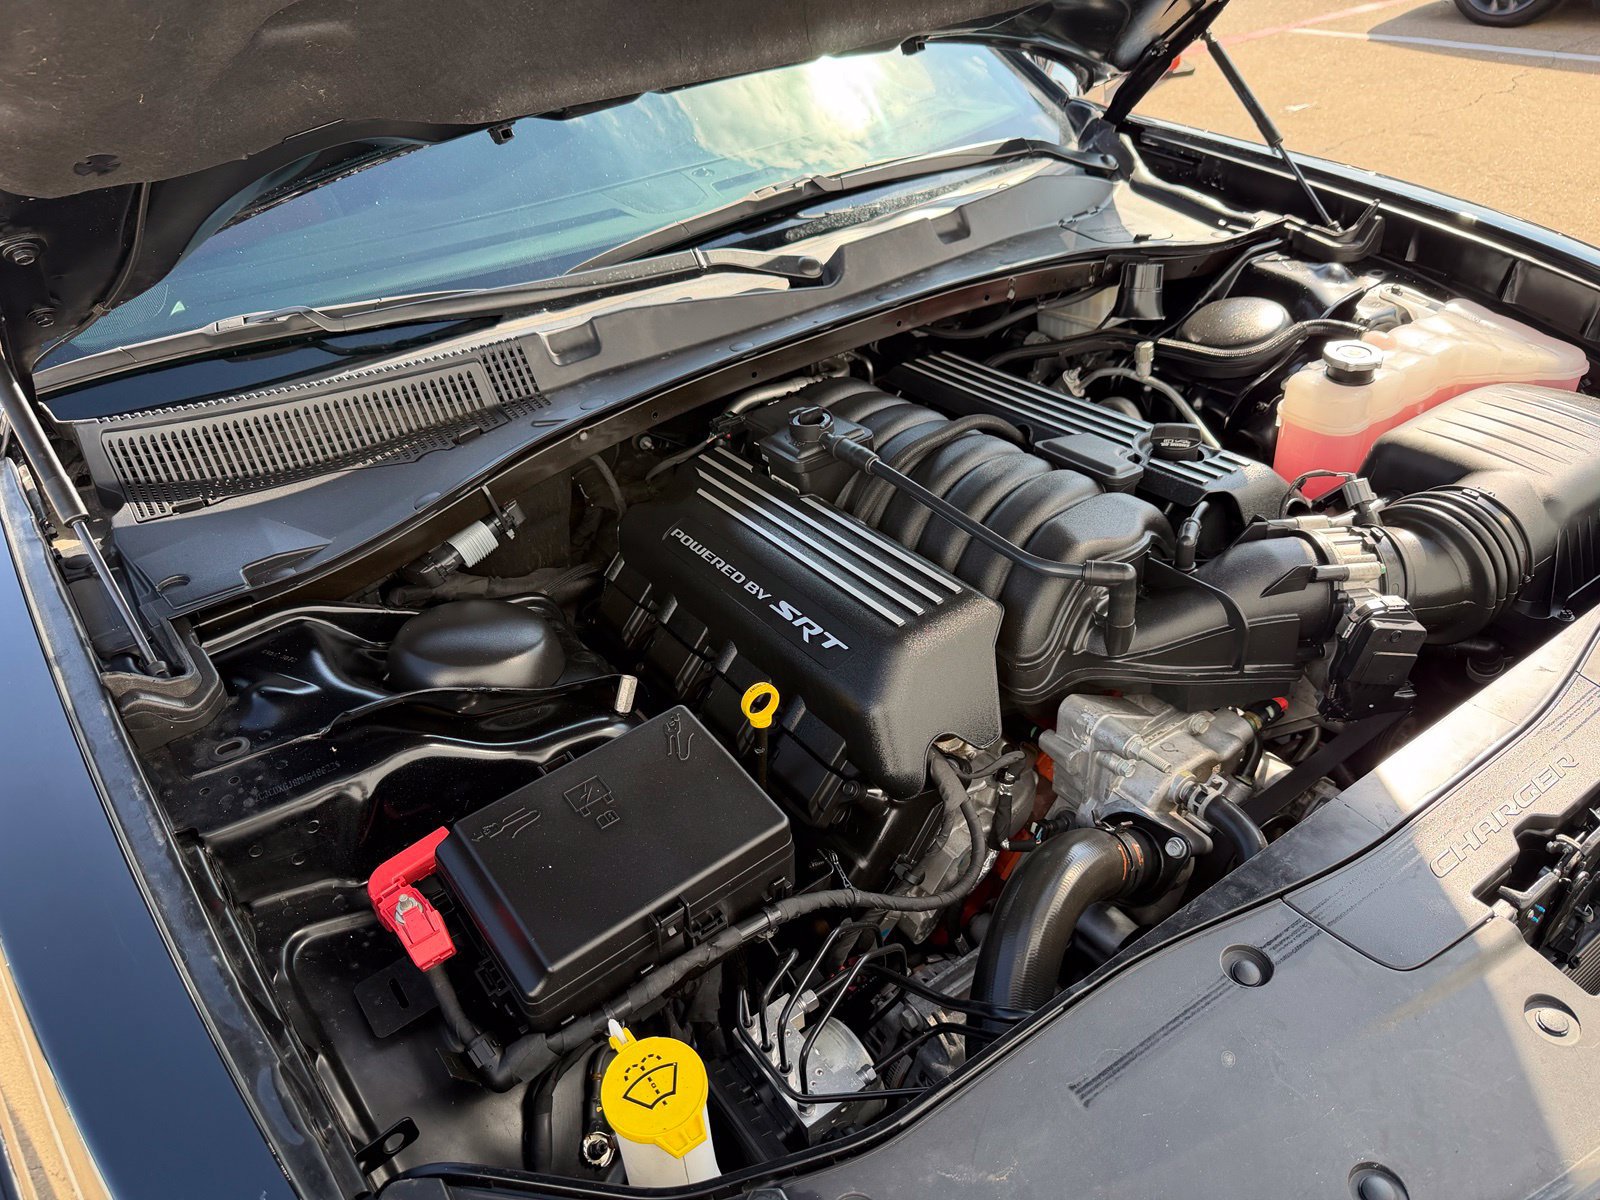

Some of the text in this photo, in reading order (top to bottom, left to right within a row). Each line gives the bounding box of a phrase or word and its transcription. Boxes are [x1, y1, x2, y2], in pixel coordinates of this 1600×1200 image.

[670, 528, 849, 650] POWERED BY SRT
[1429, 753, 1580, 878] CHARGER
